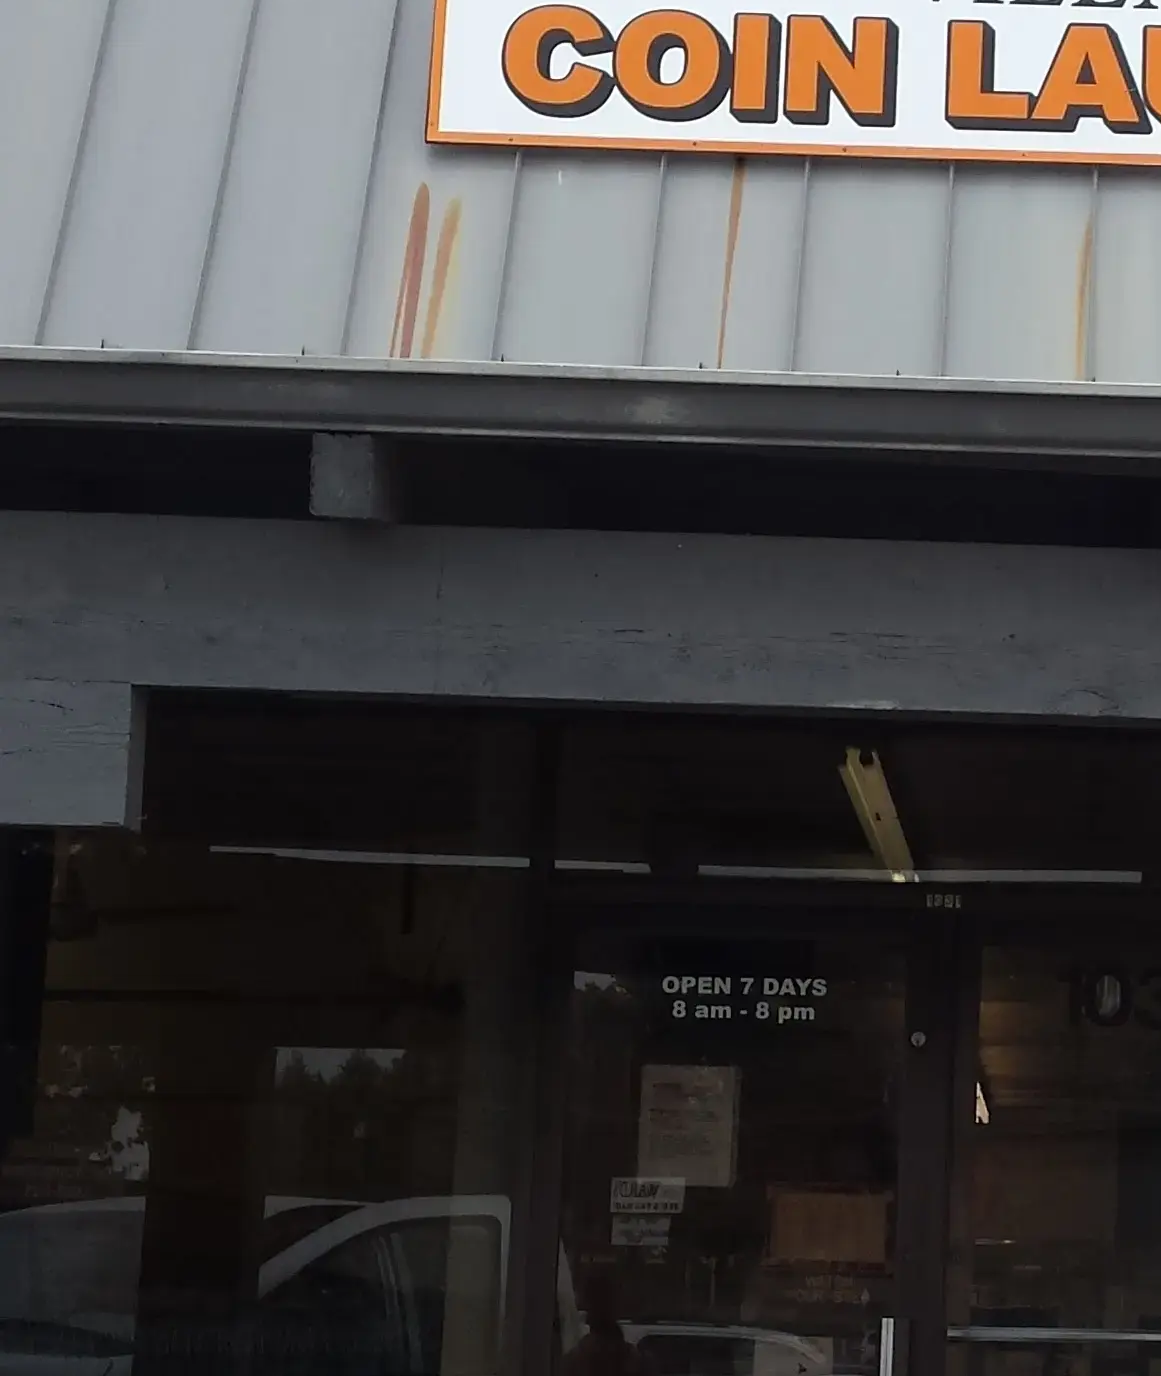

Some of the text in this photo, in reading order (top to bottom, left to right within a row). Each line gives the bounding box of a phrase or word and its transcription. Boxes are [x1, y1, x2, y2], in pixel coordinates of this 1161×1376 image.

[502, 4, 898, 129] COIN
[662, 976, 829, 997] OPEN 7 DAYS
[672, 1000, 687, 1019] 8
[694, 1004, 732, 1019] am
[755, 1001, 770, 1020] 8
[777, 1006, 816, 1024] pm
